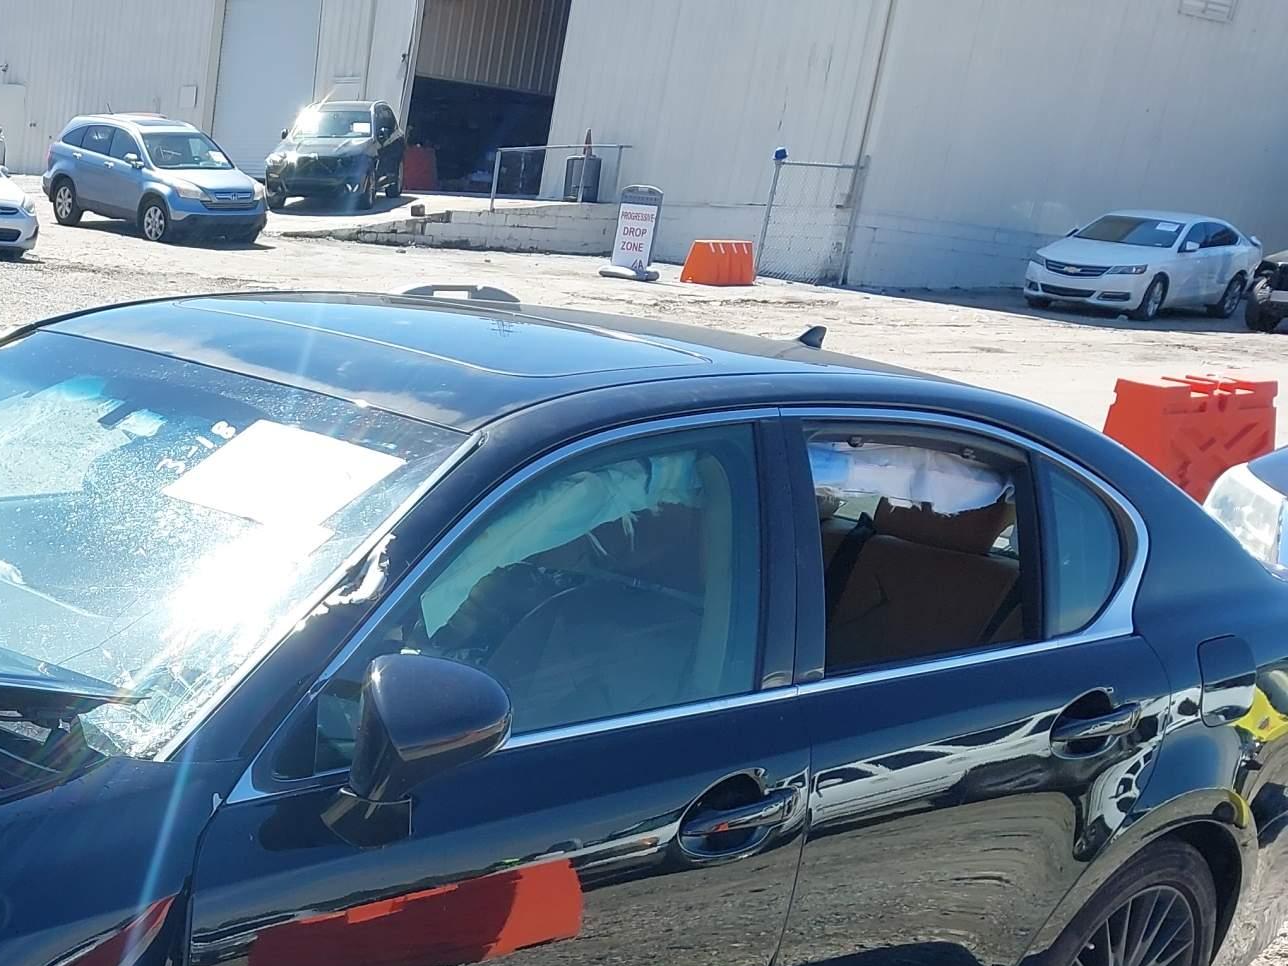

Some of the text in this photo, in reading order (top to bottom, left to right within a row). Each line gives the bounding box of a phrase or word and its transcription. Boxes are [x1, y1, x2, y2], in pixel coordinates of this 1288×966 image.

[621, 211, 654, 223] PROGRESSIVE
[623, 227, 647, 237] DROP
[621, 241, 644, 252] ZONE
